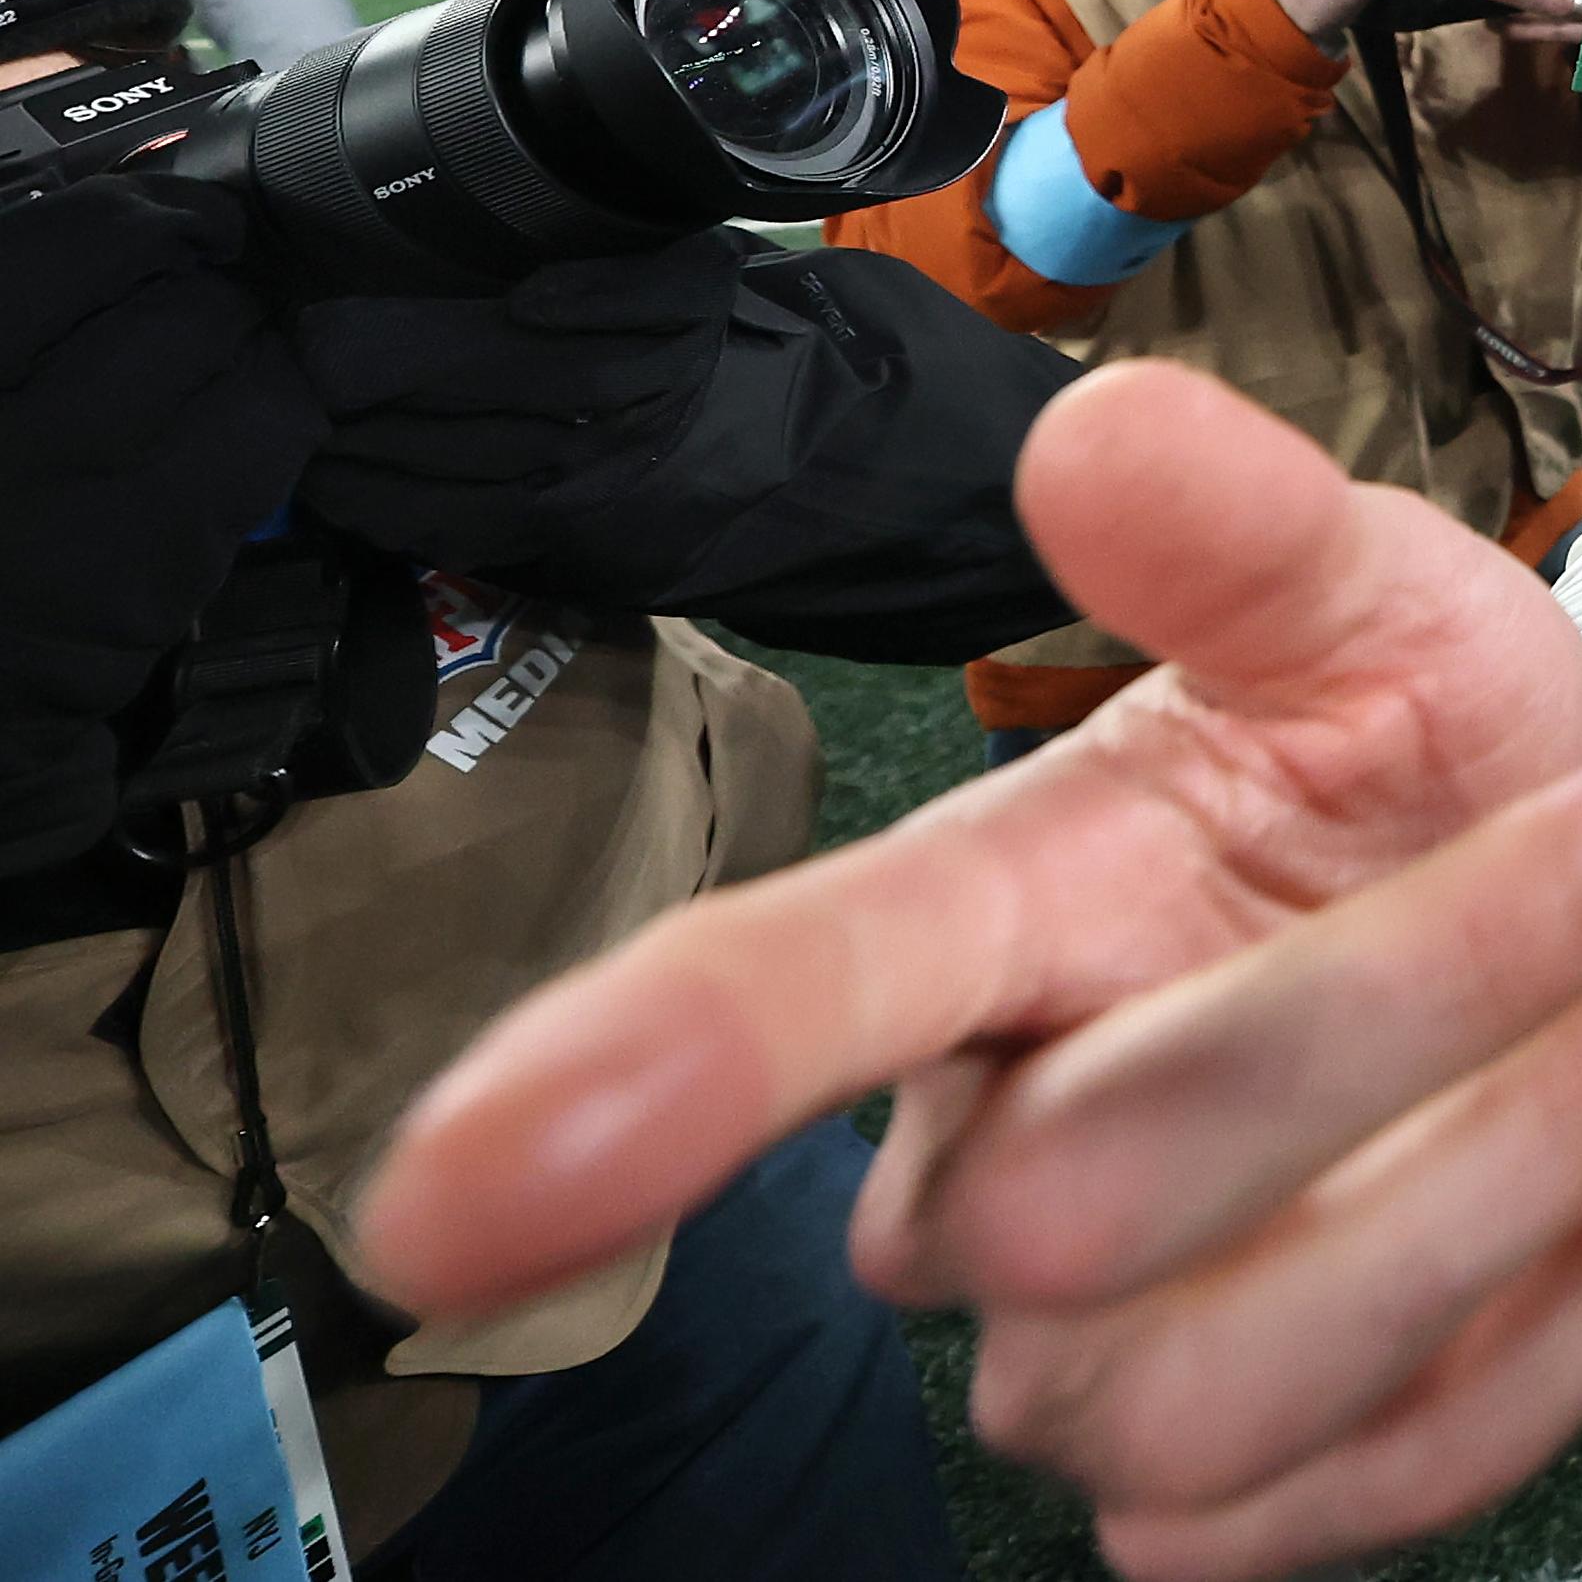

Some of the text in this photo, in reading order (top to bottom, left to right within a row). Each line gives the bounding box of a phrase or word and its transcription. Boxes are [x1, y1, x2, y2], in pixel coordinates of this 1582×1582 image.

[64, 76, 174, 124] SONY
[373, 167, 436, 201] SONY
[136, 1477, 228, 1582] WEE
[242, 1506, 282, 1561] NYJ
